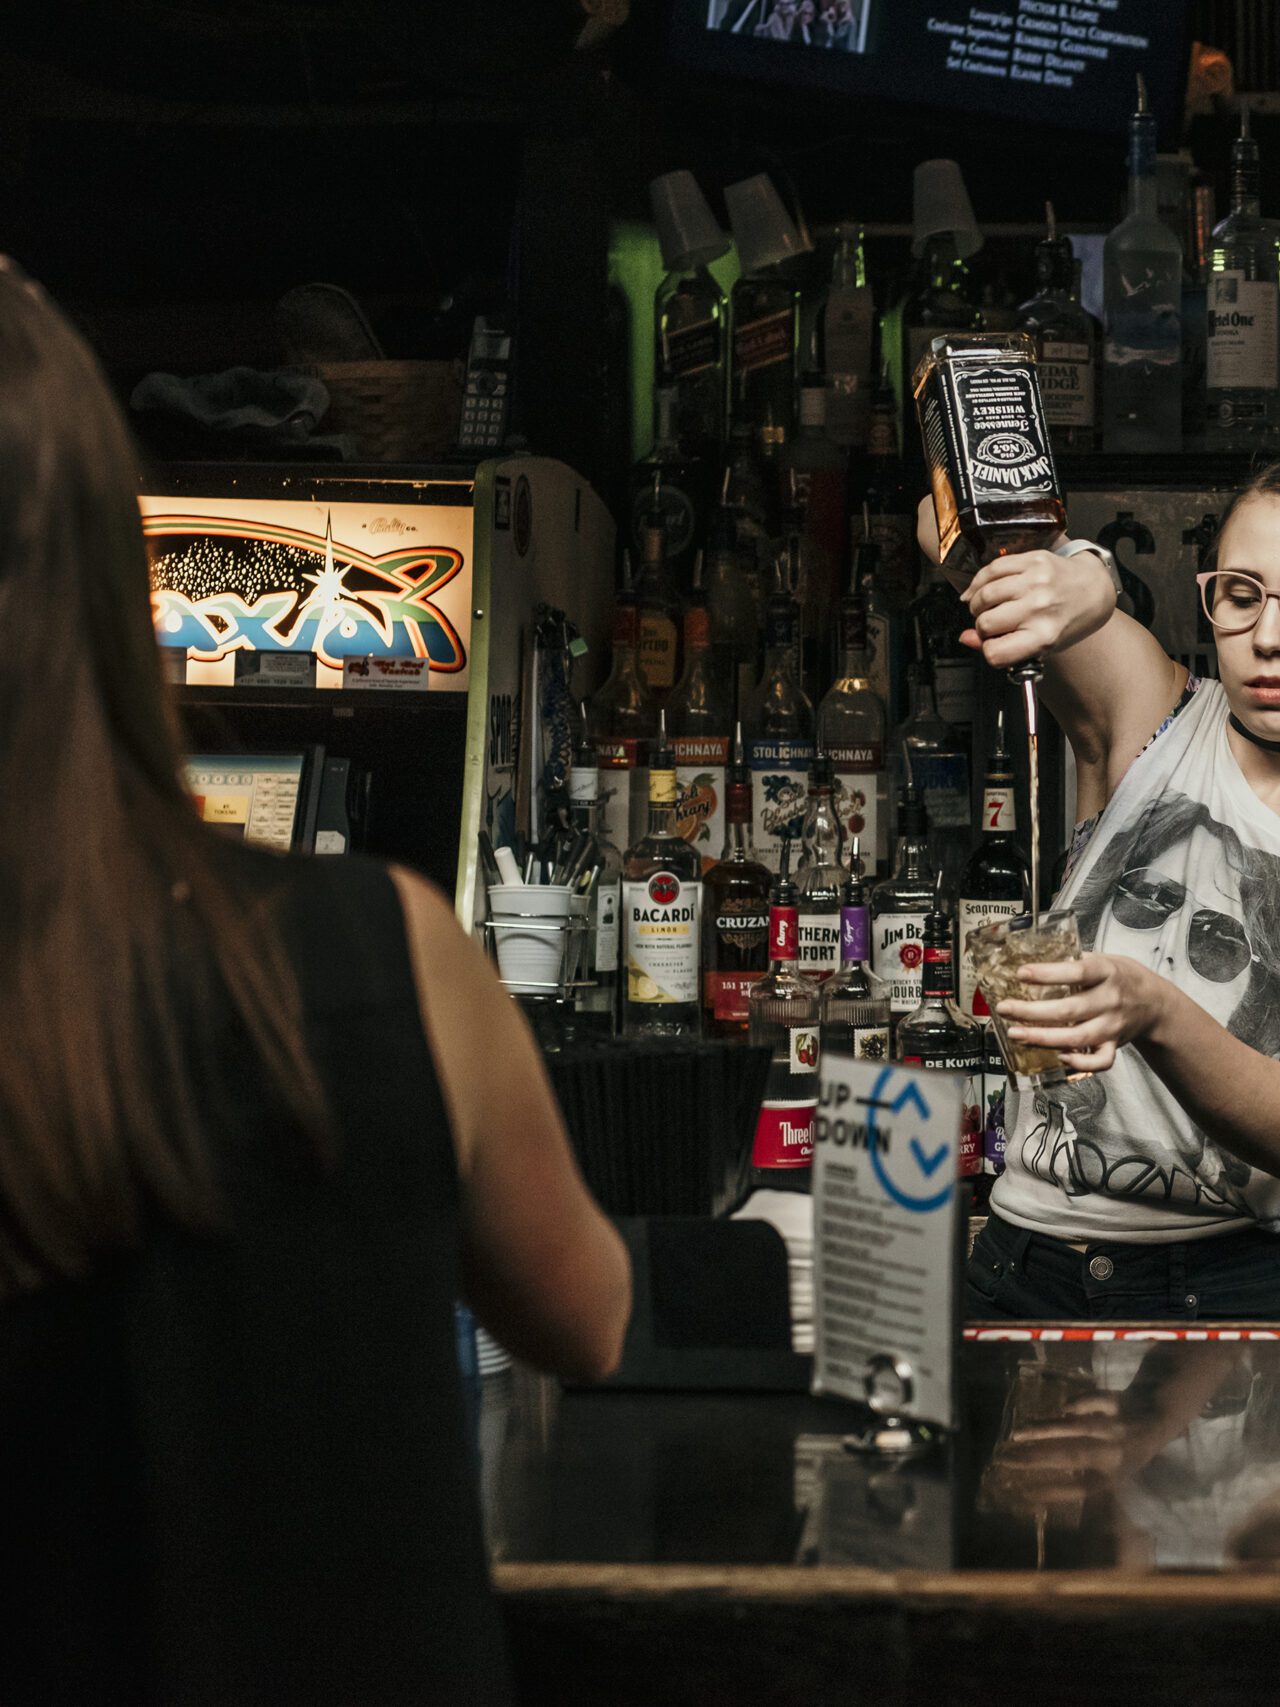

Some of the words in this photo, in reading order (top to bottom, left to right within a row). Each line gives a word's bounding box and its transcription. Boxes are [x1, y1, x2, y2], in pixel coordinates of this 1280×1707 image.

[1039, 366, 1078, 377] EDAR
[1041, 378, 1080, 390] IDGE
[972, 405, 1026, 415] WHISKEY
[974, 419, 1030, 432] Tennessee
[1019, 456, 1051, 482] JACK
[674, 743, 724, 758] ICHNAYA
[753, 746, 812, 761] STOLICHNA
[988, 802, 1005, 828] 7
[633, 903, 695, 922] BACARDÍ
[966, 901, 1017, 916] Seagram's
[799, 927, 840, 943] THERN
[881, 928, 904, 950] JIM
[906, 923, 923, 939] BE
[799, 946, 836, 960] FORT
[722, 981, 736, 990] 151
[891, 986, 922, 998] OURB
[925, 1060, 943, 1068] DE
[989, 1056, 1001, 1065] DE
[779, 1120, 809, 1147] Three
[815, 1115, 892, 1156] DOWN
